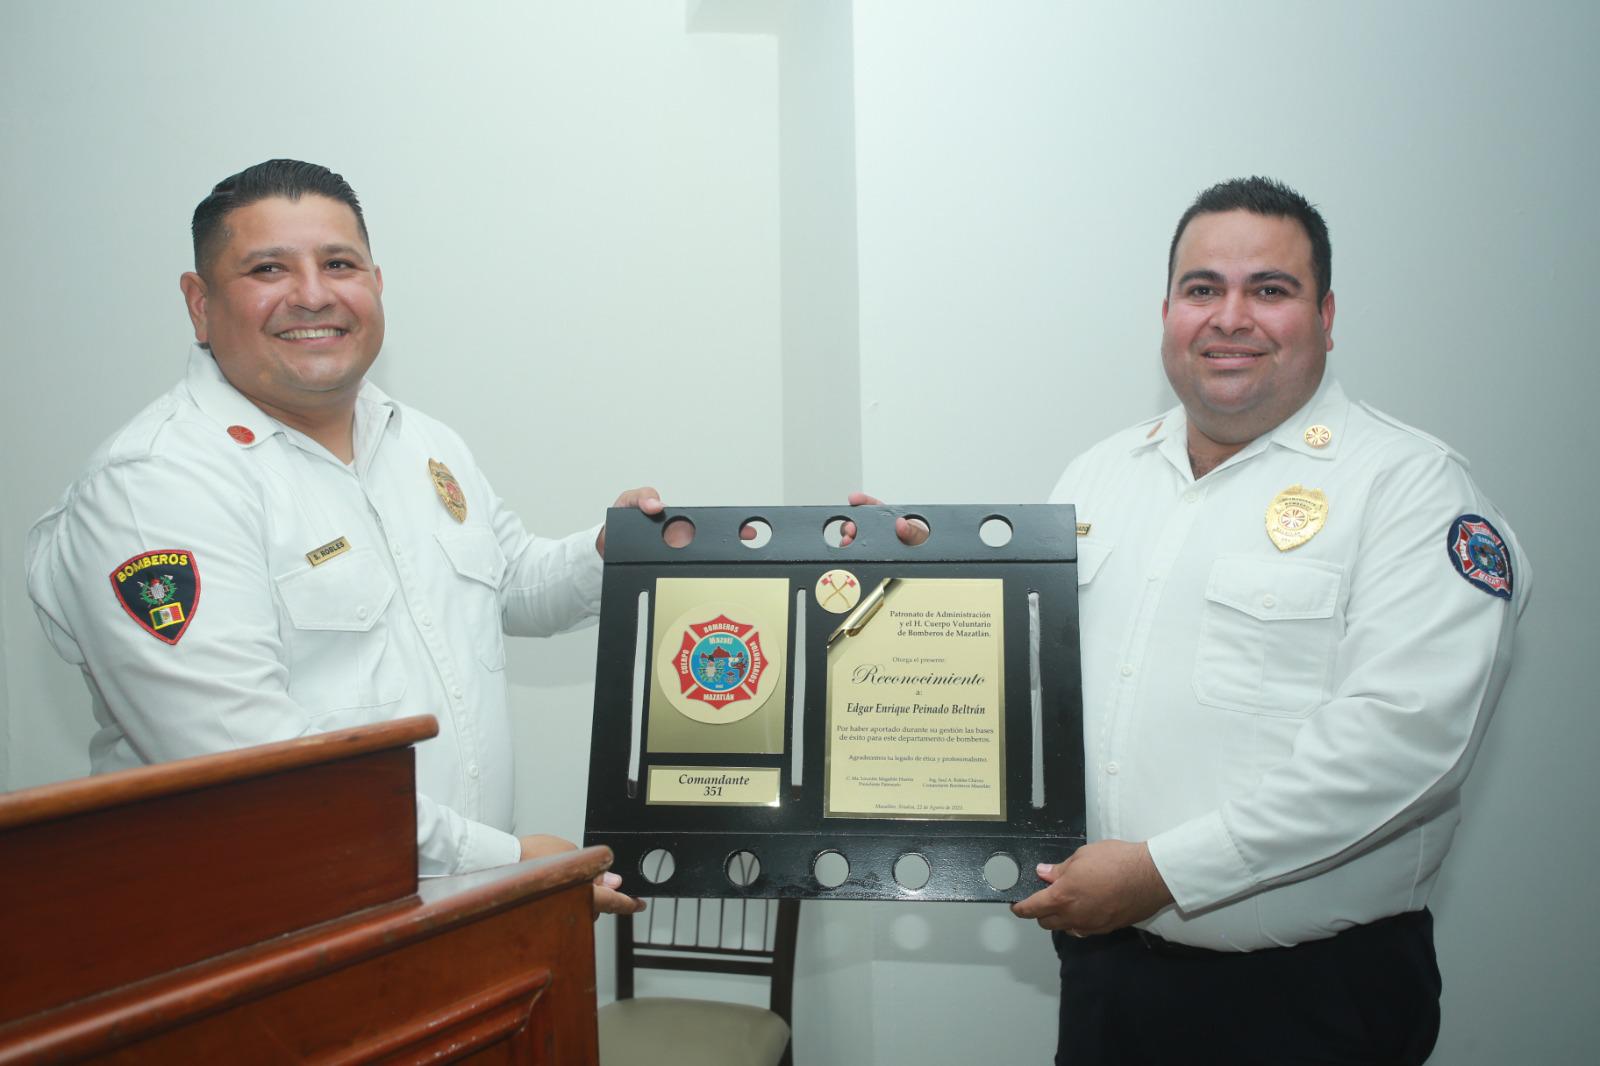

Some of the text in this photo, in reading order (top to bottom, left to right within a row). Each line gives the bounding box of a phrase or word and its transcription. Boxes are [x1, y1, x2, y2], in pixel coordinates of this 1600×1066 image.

[320, 541, 345, 557] ROBLES
[116, 553, 188, 582] BOMBEROS
[890, 610, 991, 618] Patronato de Administración
[703, 623, 739, 633] BOMBEROS
[924, 620, 951, 629] Cuerpo
[952, 620, 992, 628] Voluntario
[897, 629, 906, 637] de
[908, 629, 944, 637] Bomberos
[681, 649, 690, 675] CUERPO
[748, 640, 761, 684] VOLUNTARIOS
[851, 663, 986, 686] Reconocimiento
[847, 702, 986, 716] Edgar Enrique Peinado Beltrán
[870, 725, 901, 734] aportado
[965, 726, 975, 734] las
[975, 726, 994, 734] bases
[867, 735, 882, 743] para
[898, 735, 945, 743] departamento
[678, 773, 750, 785] Comandante
[703, 786, 722, 797] 351
